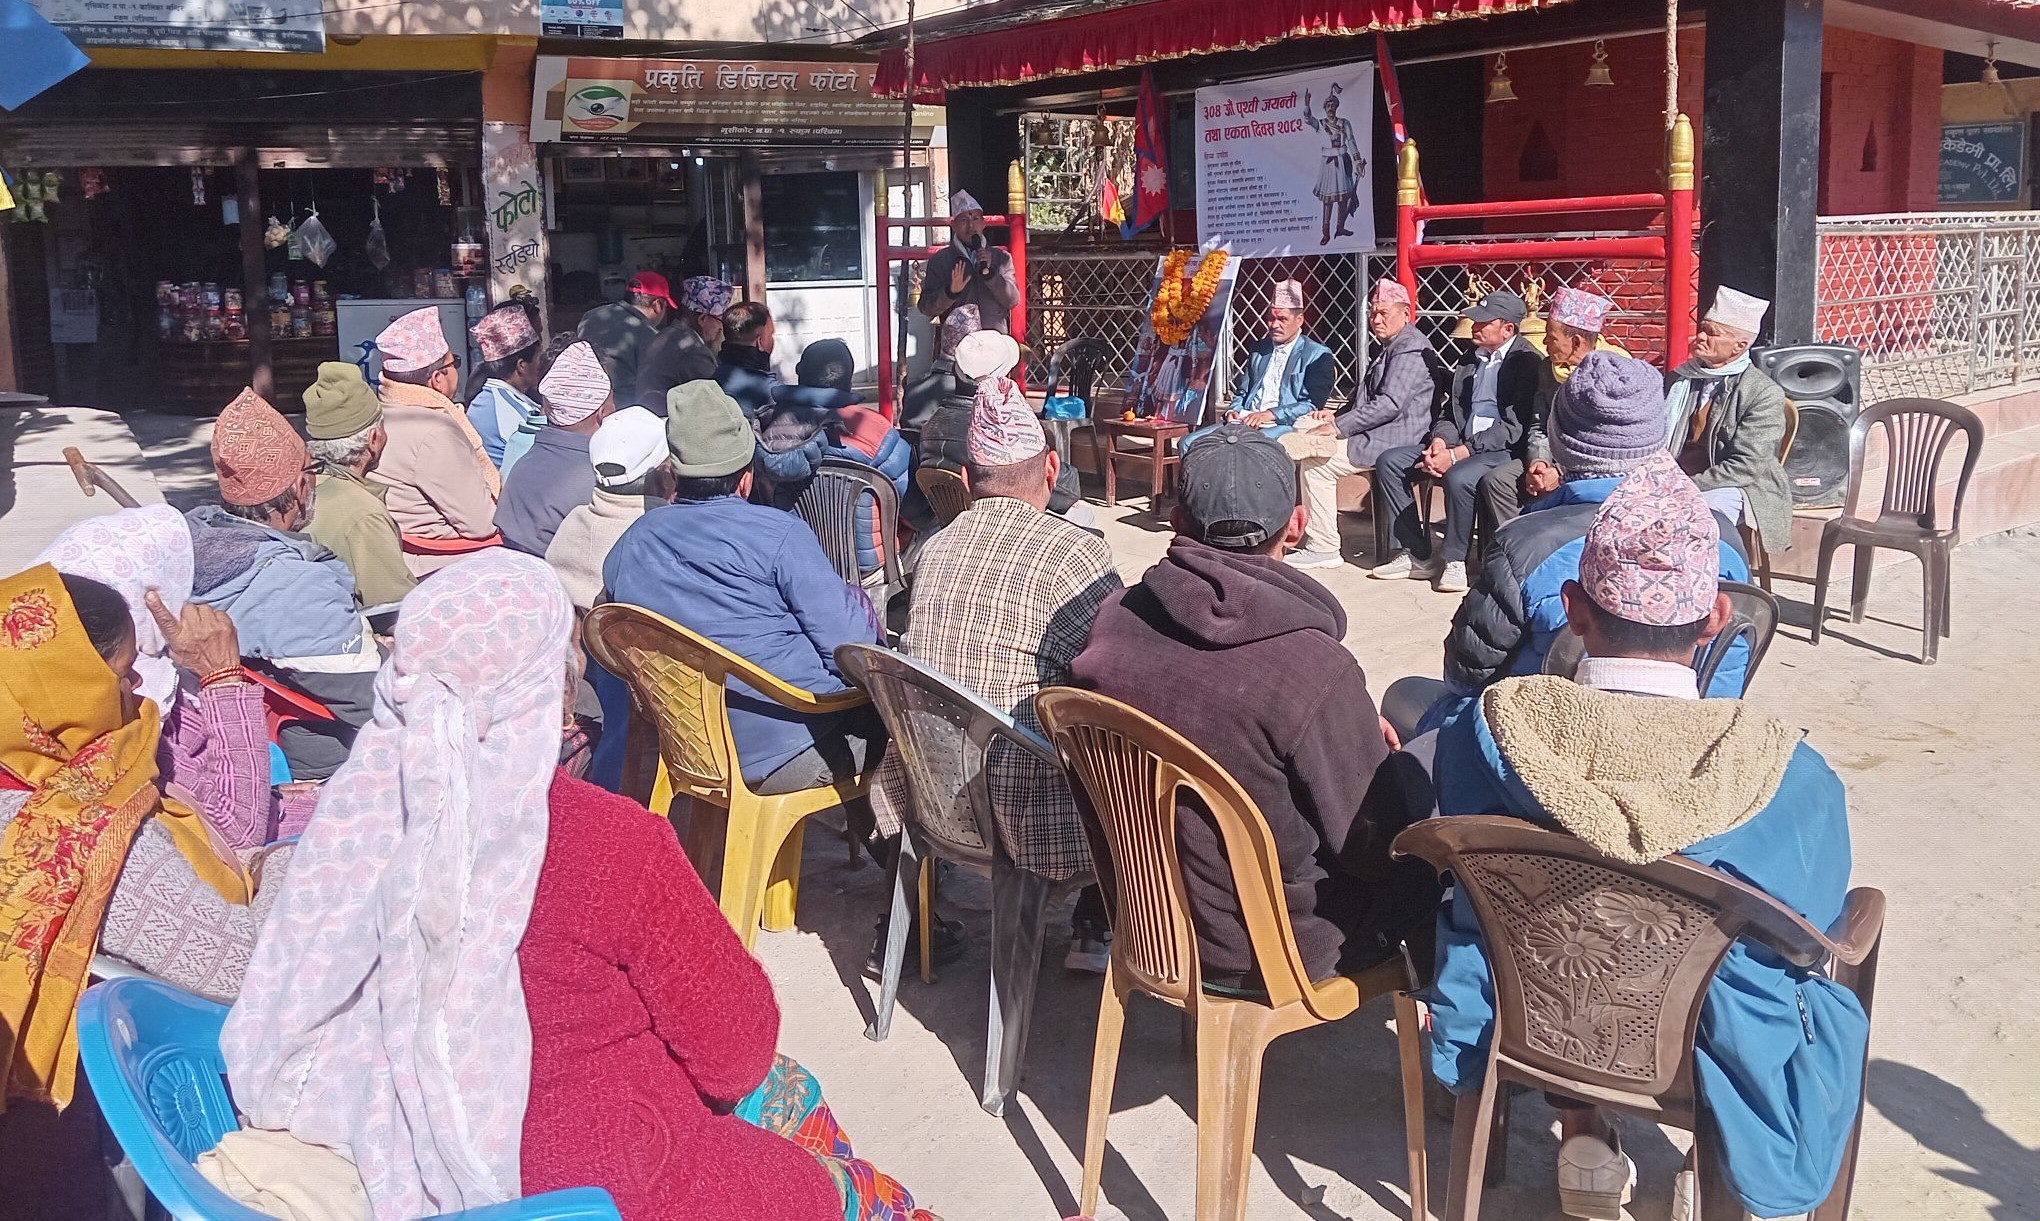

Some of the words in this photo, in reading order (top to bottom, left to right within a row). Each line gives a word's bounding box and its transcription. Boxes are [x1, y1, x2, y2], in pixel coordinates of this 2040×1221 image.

[645, 64, 704, 93] प्रकृति
[715, 65, 798, 91] डिजिटल
[809, 68, 860, 92] फोटो
[1203, 105, 1221, 120] ३०४
[1236, 96, 1260, 119] पृथ्वी
[1261, 91, 1298, 112] जयन्ती
[1204, 128, 1221, 143] तथा
[1224, 125, 1251, 140] एकता
[1251, 120, 1275, 138] दिवस
[1277, 118, 1303, 134] २०८२
[1940, 136, 1985, 159] केडेमी
[492, 181, 538, 233] फोटो
[495, 239, 540, 275] स्टुडियो
